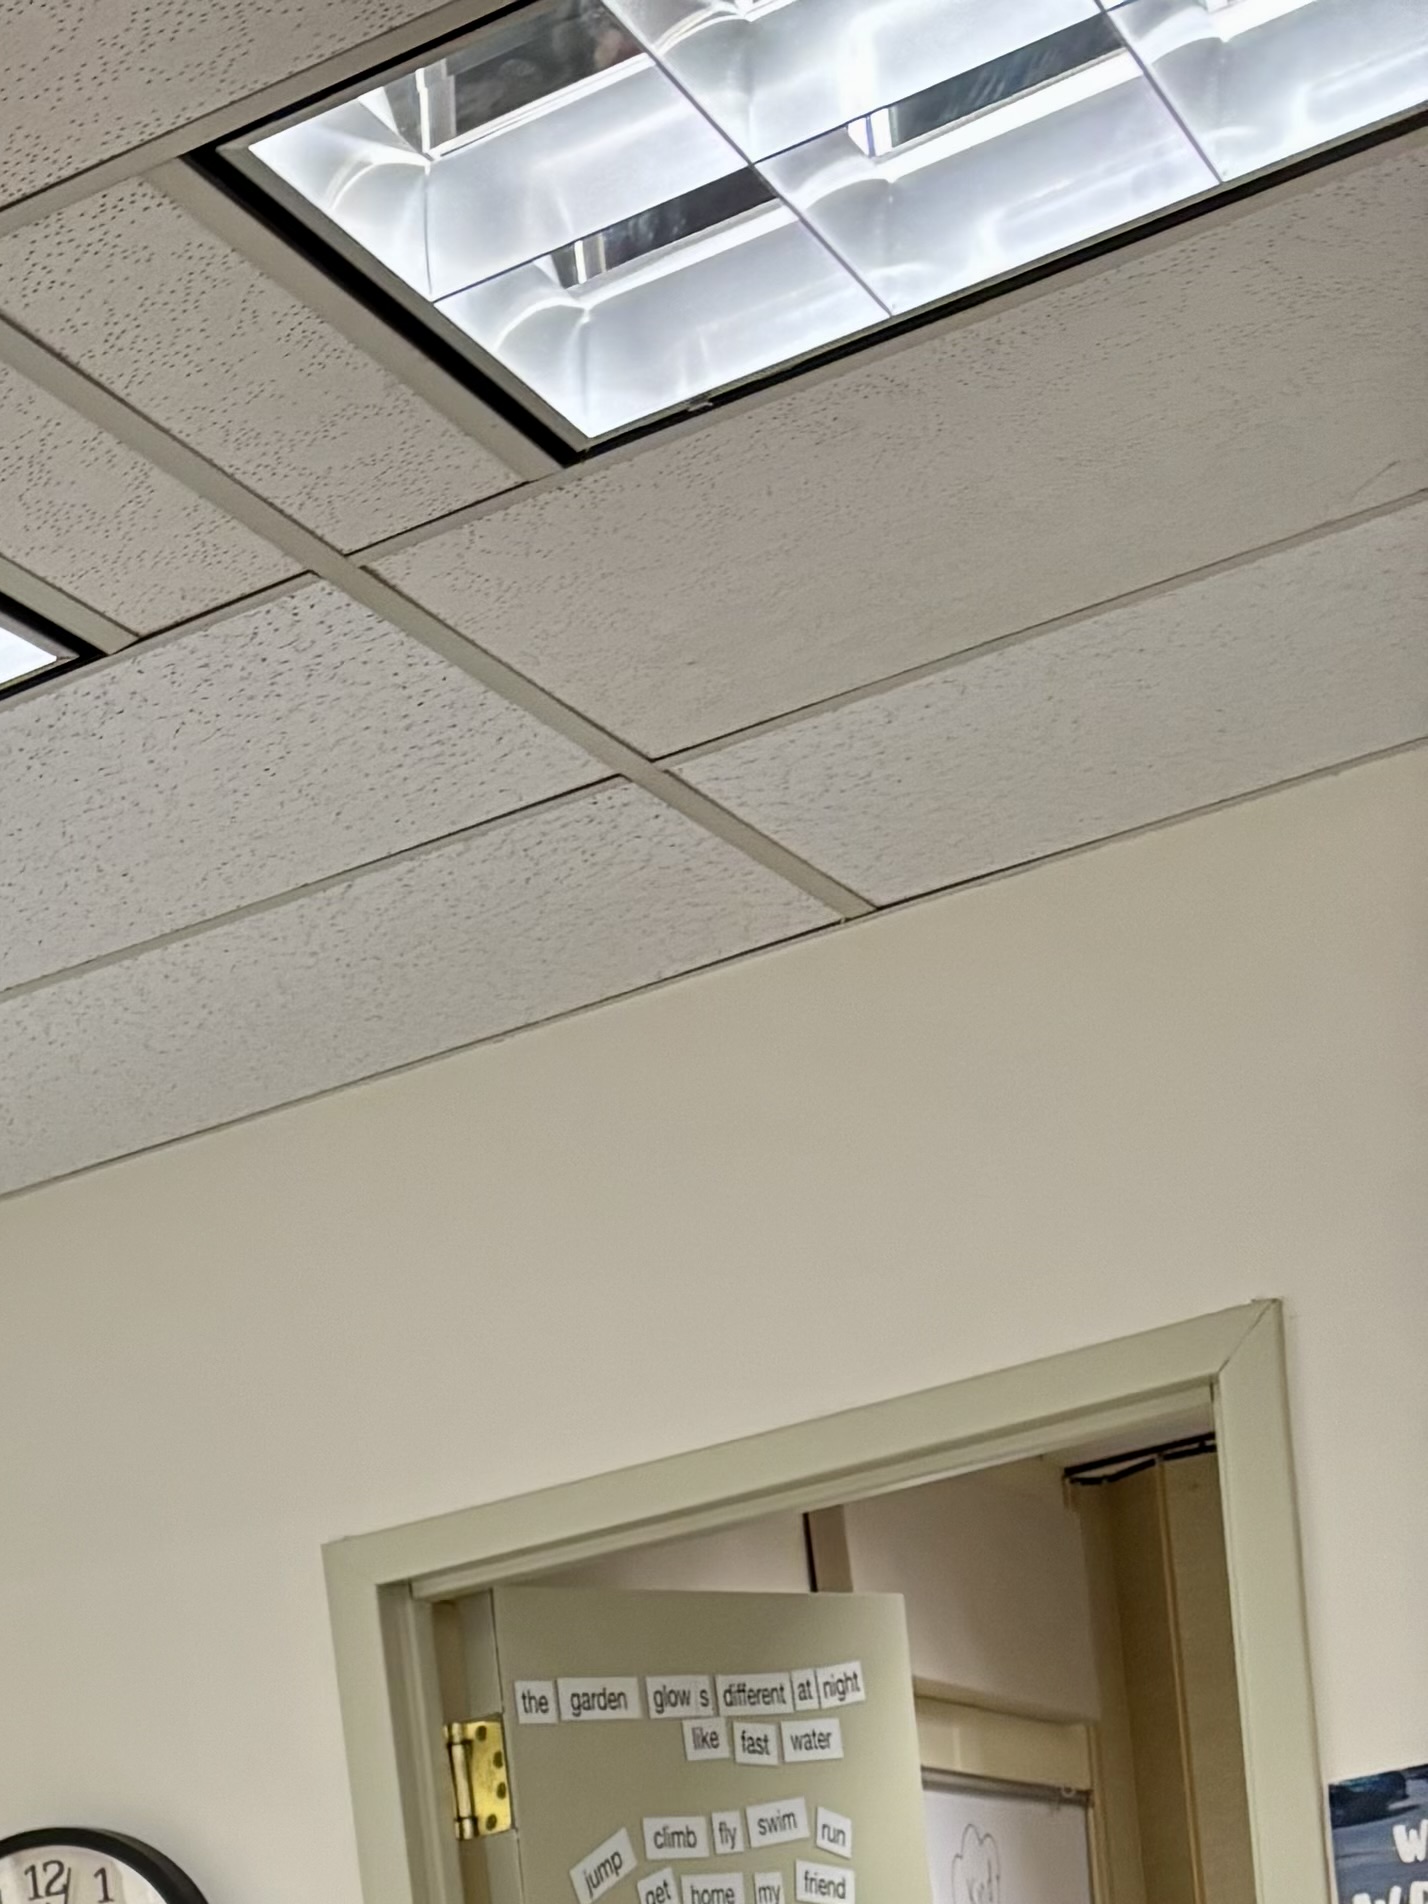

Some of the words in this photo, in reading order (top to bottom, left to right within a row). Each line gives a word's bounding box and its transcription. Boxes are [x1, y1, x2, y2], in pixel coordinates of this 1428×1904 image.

[521, 1691, 549, 1713] the
[570, 1688, 628, 1716] garden
[723, 1681, 786, 1707] different
[797, 1681, 812, 1700] at
[823, 1672, 861, 1700] night
[693, 1727, 719, 1750] like
[741, 1730, 770, 1755] fast
[790, 1730, 832, 1751] water
[583, 1849, 624, 1899] jump
[653, 1826, 697, 1849] climb
[719, 1821, 737, 1849] fly
[757, 1810, 798, 1836] swim
[821, 1822, 846, 1845] run
[24, 1860, 67, 1901] 12
[93, 1867, 114, 1904] 1
[803, 1870, 846, 1900] friend
